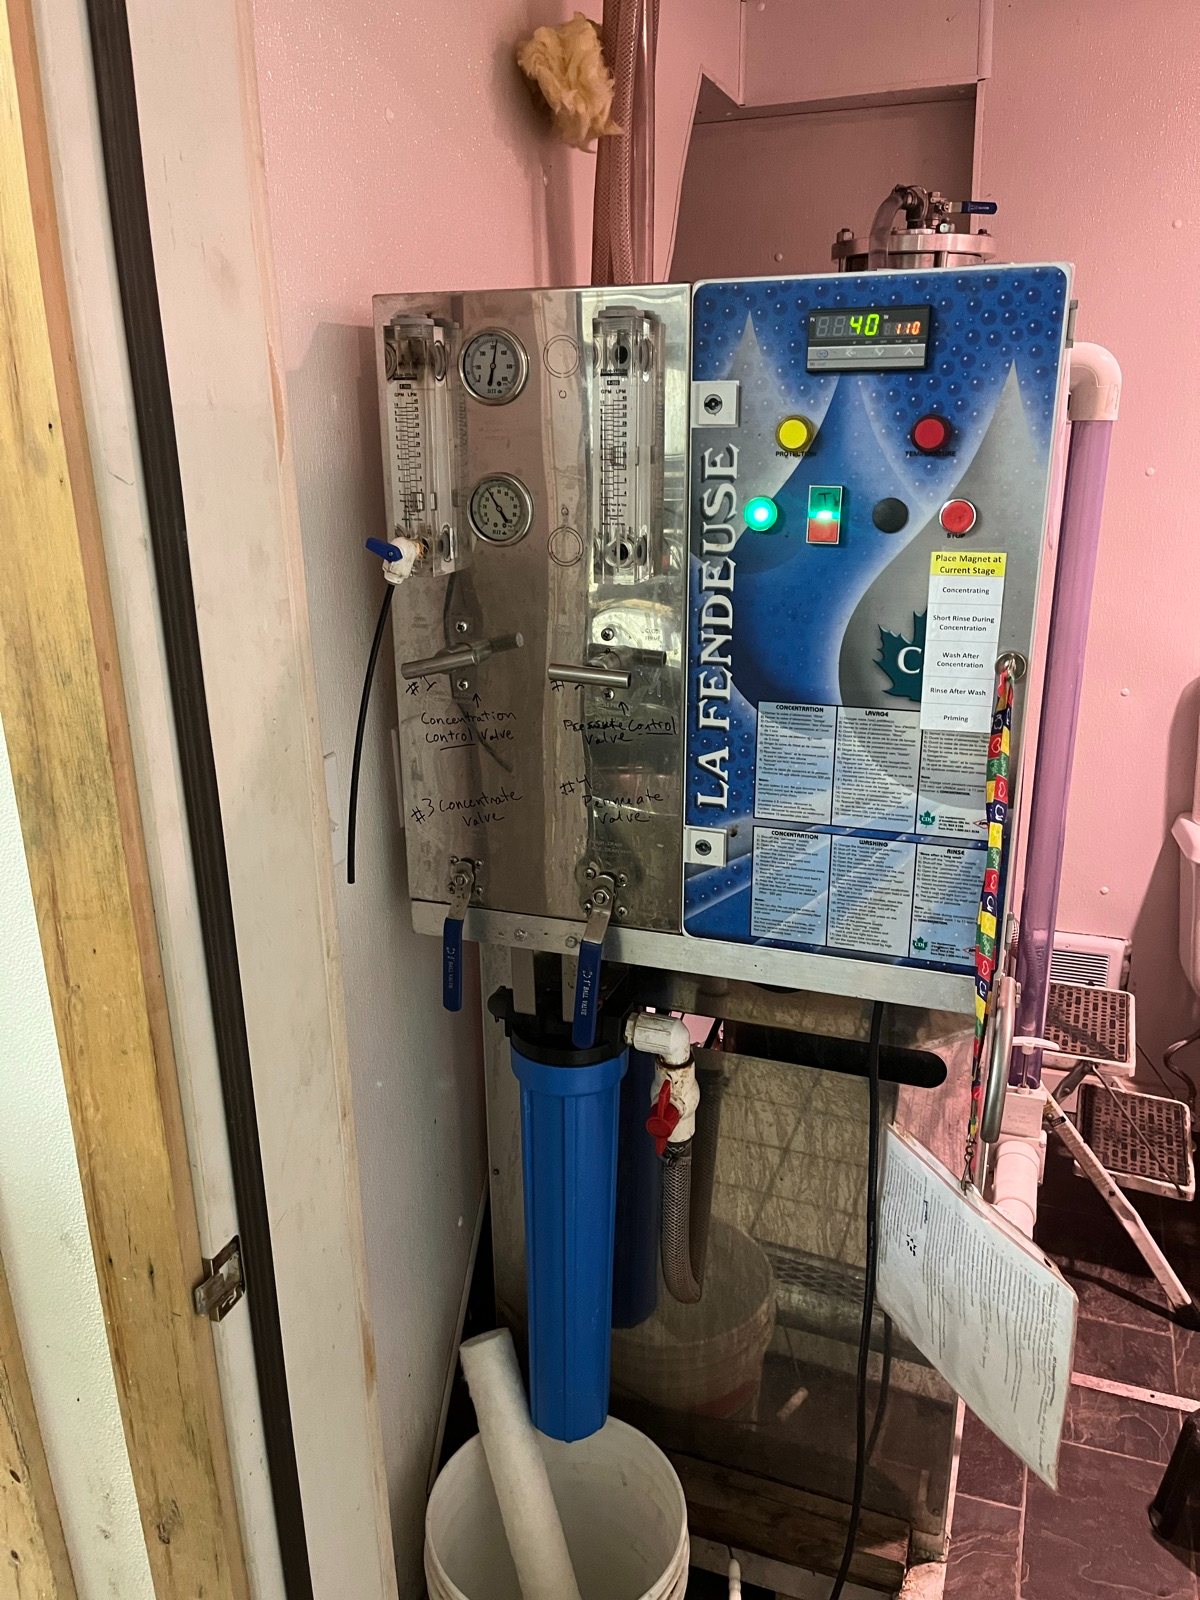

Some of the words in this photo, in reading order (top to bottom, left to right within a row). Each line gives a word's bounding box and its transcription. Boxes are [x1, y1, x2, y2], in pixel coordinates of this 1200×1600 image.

[849, 314, 880, 336] 40
[896, 320, 921, 335] 110
[959, 555, 990, 564] Magnet
[698, 442, 740, 732] FENDEUSE
[942, 586, 990, 595] Concentrating
[972, 616, 995, 624] During
[897, 646, 922, 674] C
[776, 704, 824, 713] CONCENTRATION
[421, 710, 517, 725] Concentration
[943, 714, 969, 722] Priming
[560, 774, 592, 796] #4
[697, 746, 729, 809] LA
[411, 798, 434, 824] #3
[440, 786, 523, 812] Concentrate
[772, 830, 819, 840] CONCENTRATION
